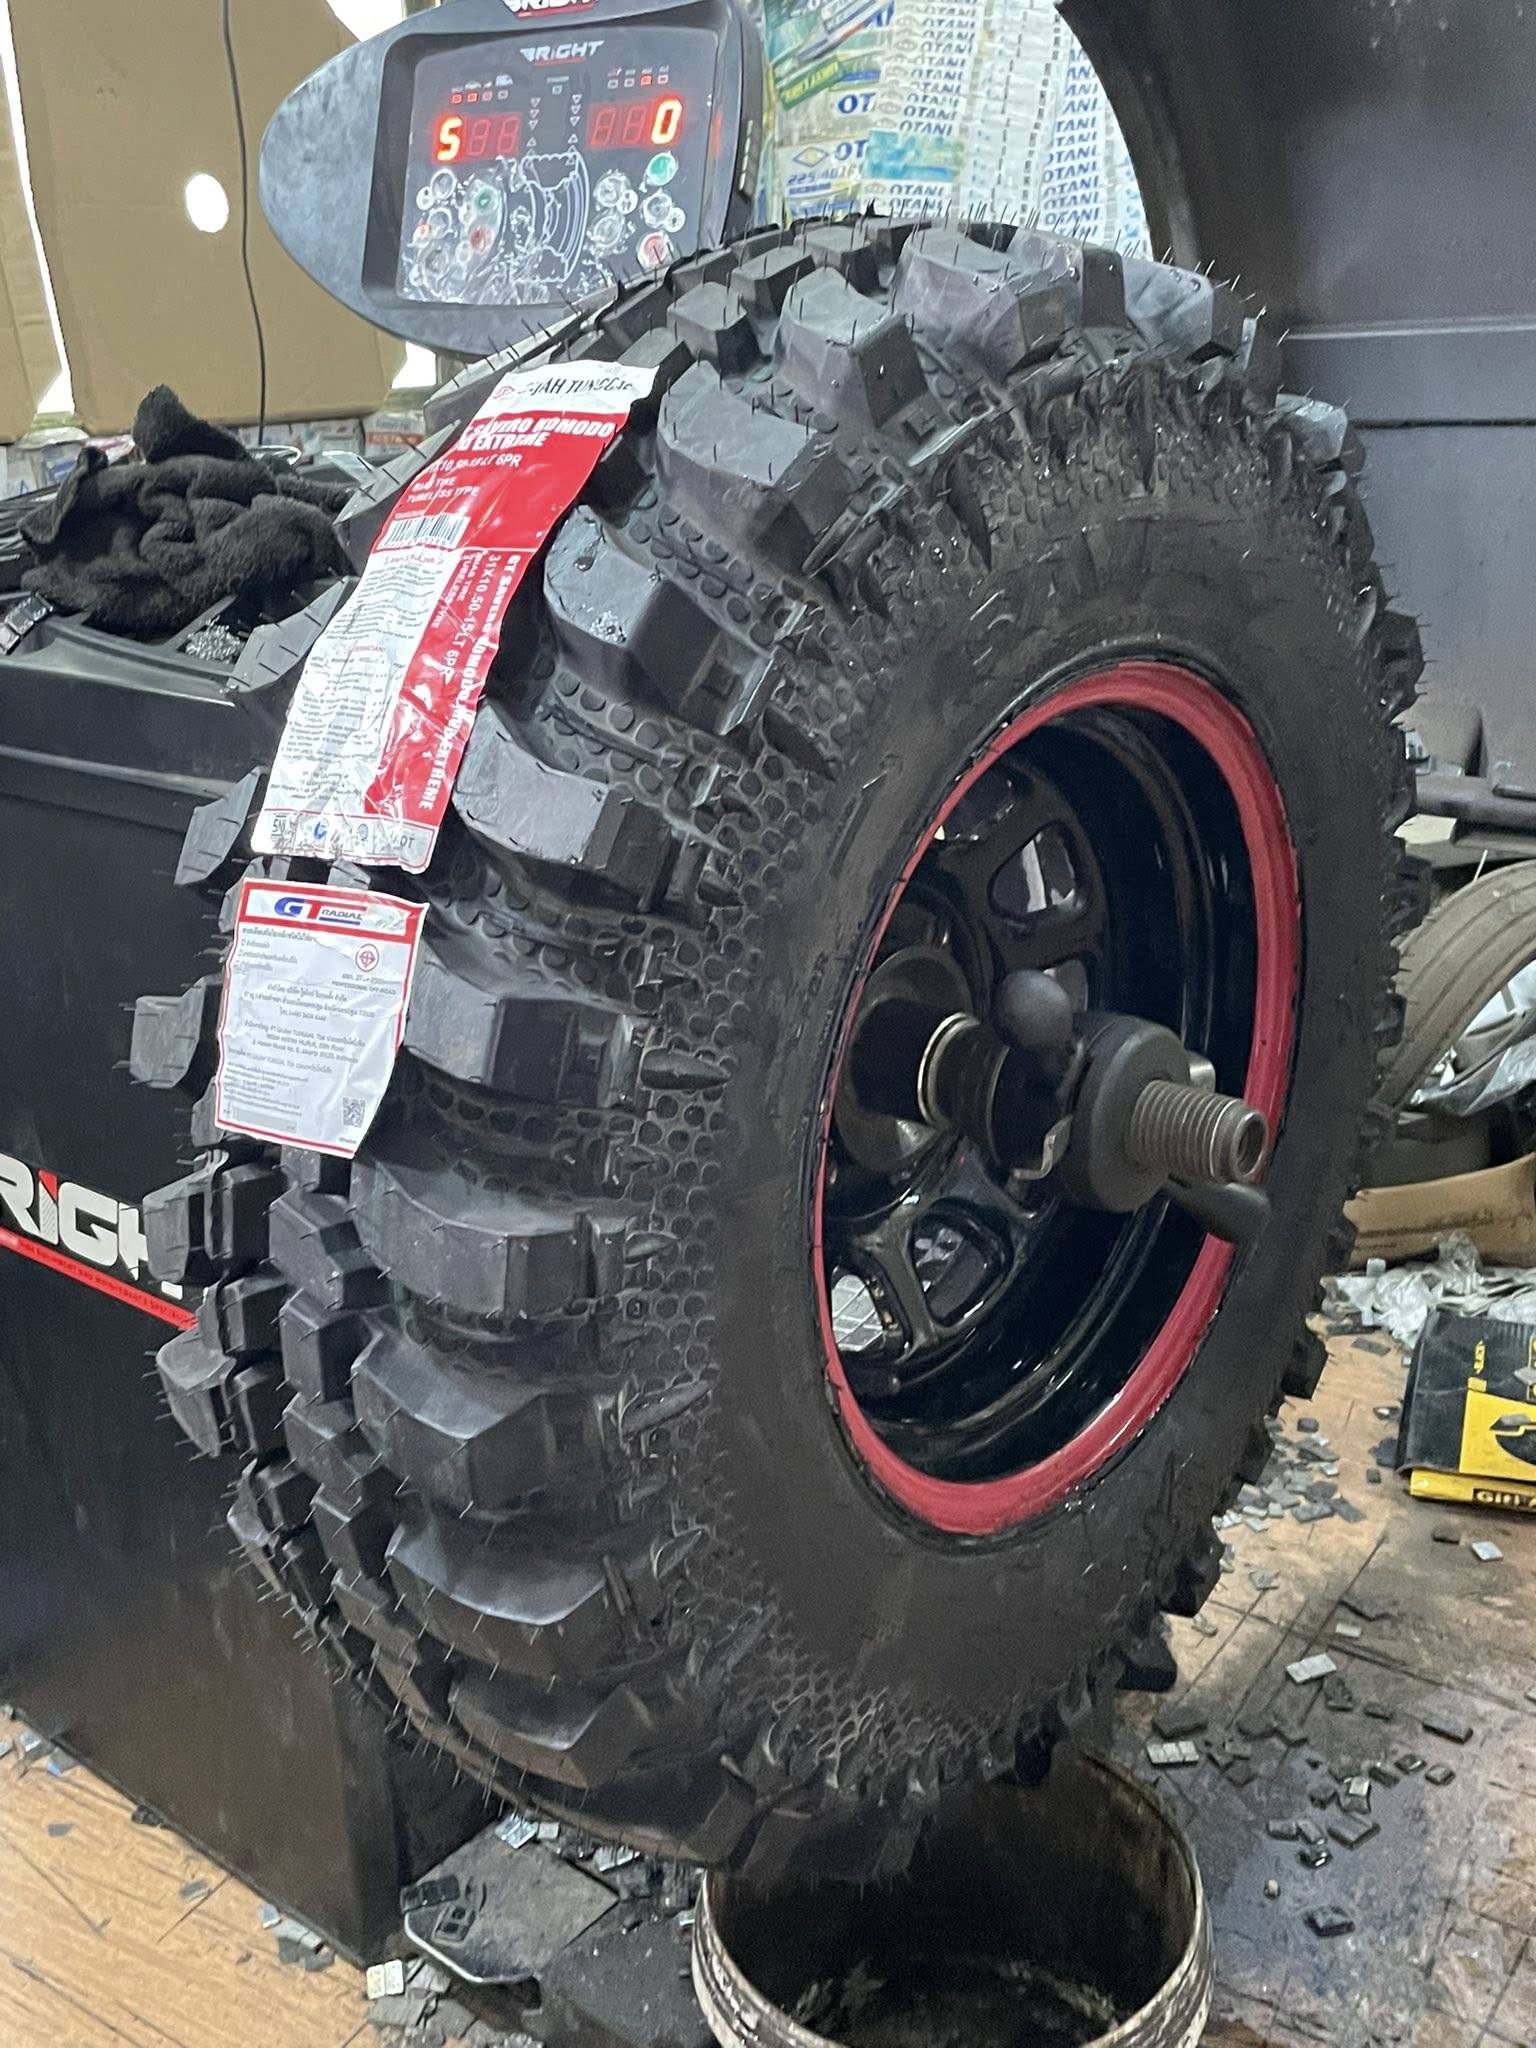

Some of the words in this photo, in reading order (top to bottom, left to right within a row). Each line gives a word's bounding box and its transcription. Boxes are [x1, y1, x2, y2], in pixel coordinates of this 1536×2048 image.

[1064, 82, 1097, 97] ANI
[904, 105, 957, 120] OTANI
[1062, 98, 1098, 114] ANI
[651, 98, 683, 146] 0
[900, 120, 952, 136] OTANI
[1056, 117, 1097, 133] TANI
[1056, 131, 1098, 147] TANI
[1042, 161, 1097, 183] OTANI
[889, 183, 944, 197] OTANI
[1044, 207, 1099, 226] OTANI
[532, 417, 617, 438] KOMODO
[321, 908, 363, 921] RADIAL
